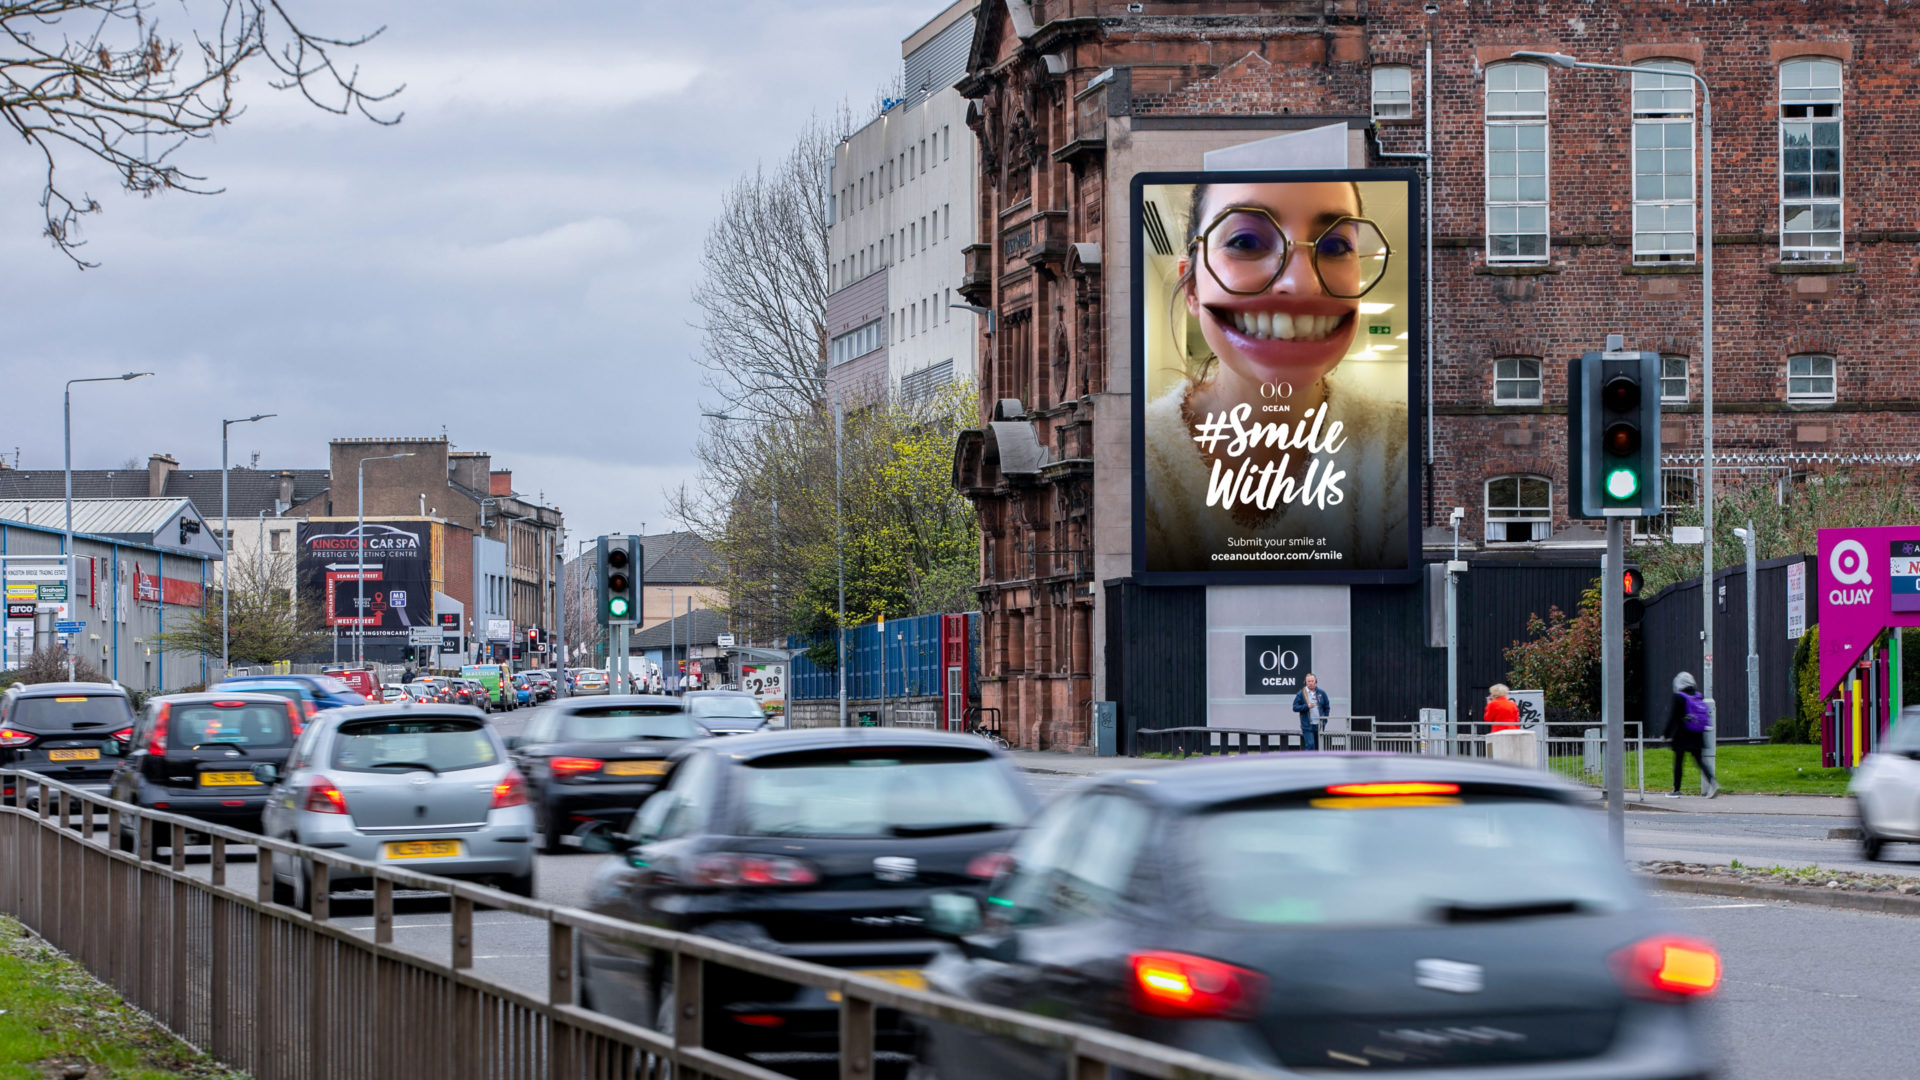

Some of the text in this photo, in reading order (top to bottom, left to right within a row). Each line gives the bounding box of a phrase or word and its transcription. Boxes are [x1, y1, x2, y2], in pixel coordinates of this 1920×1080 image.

[1193, 401, 1348, 457] #Smile
[370, 539, 394, 549] CAR
[396, 539, 416, 548] SPA
[1227, 537, 1327, 548] Submit your smile at
[1211, 550, 1343, 560] oceanoutdoor.com/smile
[1829, 588, 1874, 605] QUAY
[10, 605, 33, 613] arco
[746, 676, 780, 695] £2.99
[1262, 677, 1296, 686] OCEAN
